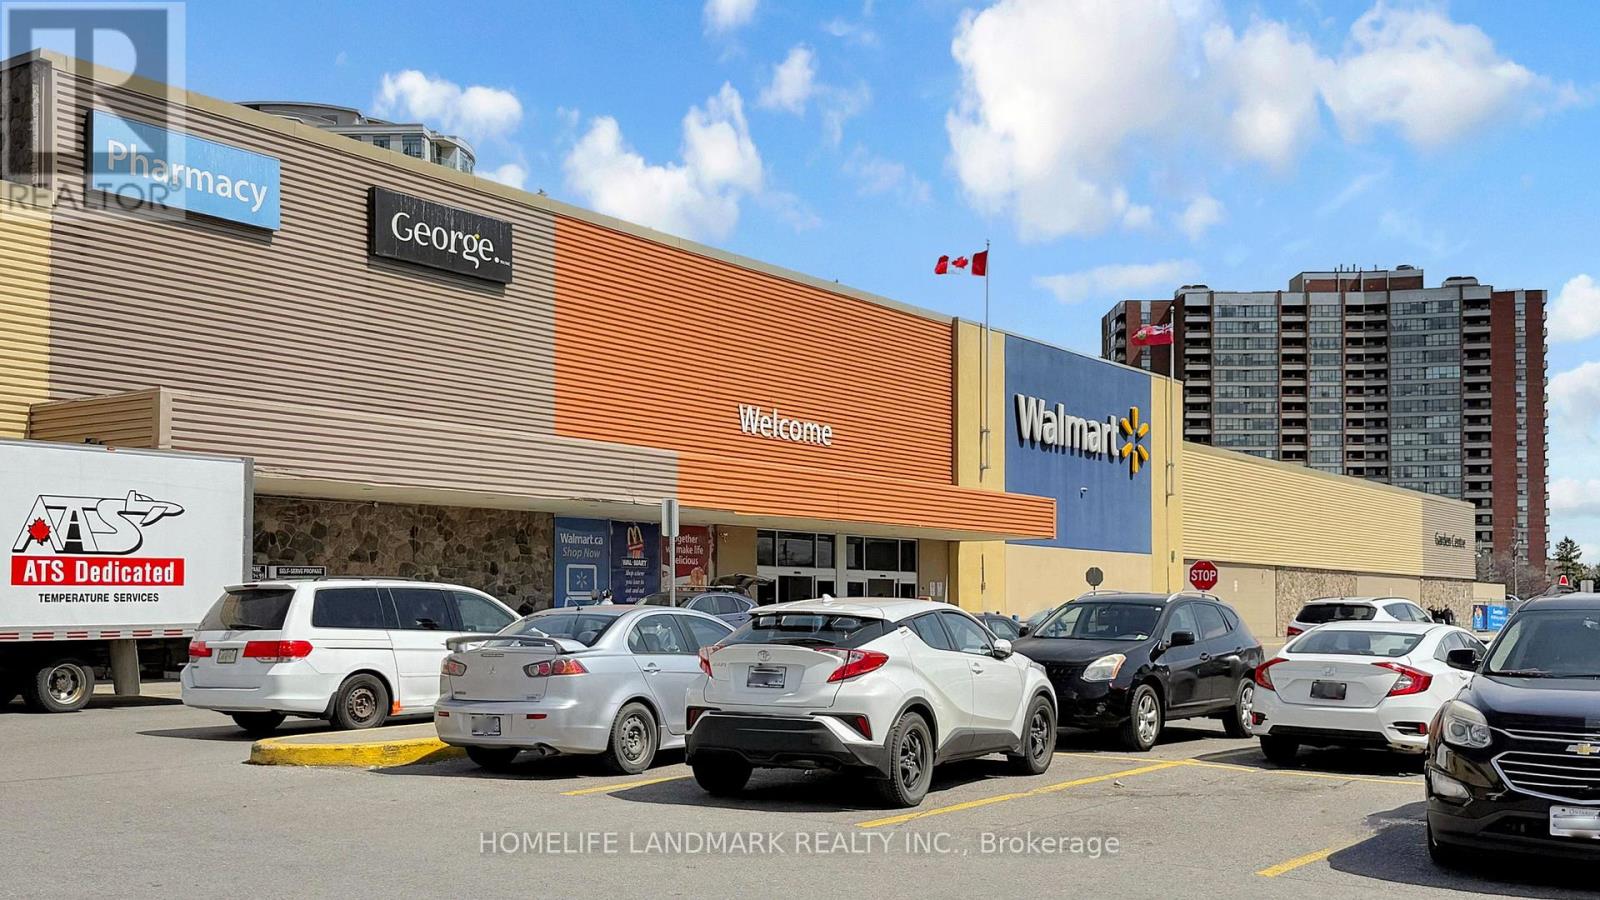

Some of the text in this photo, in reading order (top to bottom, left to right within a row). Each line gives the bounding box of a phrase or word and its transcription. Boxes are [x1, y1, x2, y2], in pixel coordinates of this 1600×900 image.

[107, 138, 268, 212] Pharmacy
[738, 403, 833, 446] Welcome
[1014, 393, 1120, 457] Walmart
[560, 532, 604, 545] Walmart.ca
[562, 546, 601, 559] Shop Now
[693, 545, 704, 554] life
[675, 556, 698, 565] elicious
[23, 560, 175, 583] ATS Dedicated
[1191, 569, 1217, 582] STOP
[38, 593, 159, 603] TEMPERATURE SERVICES
